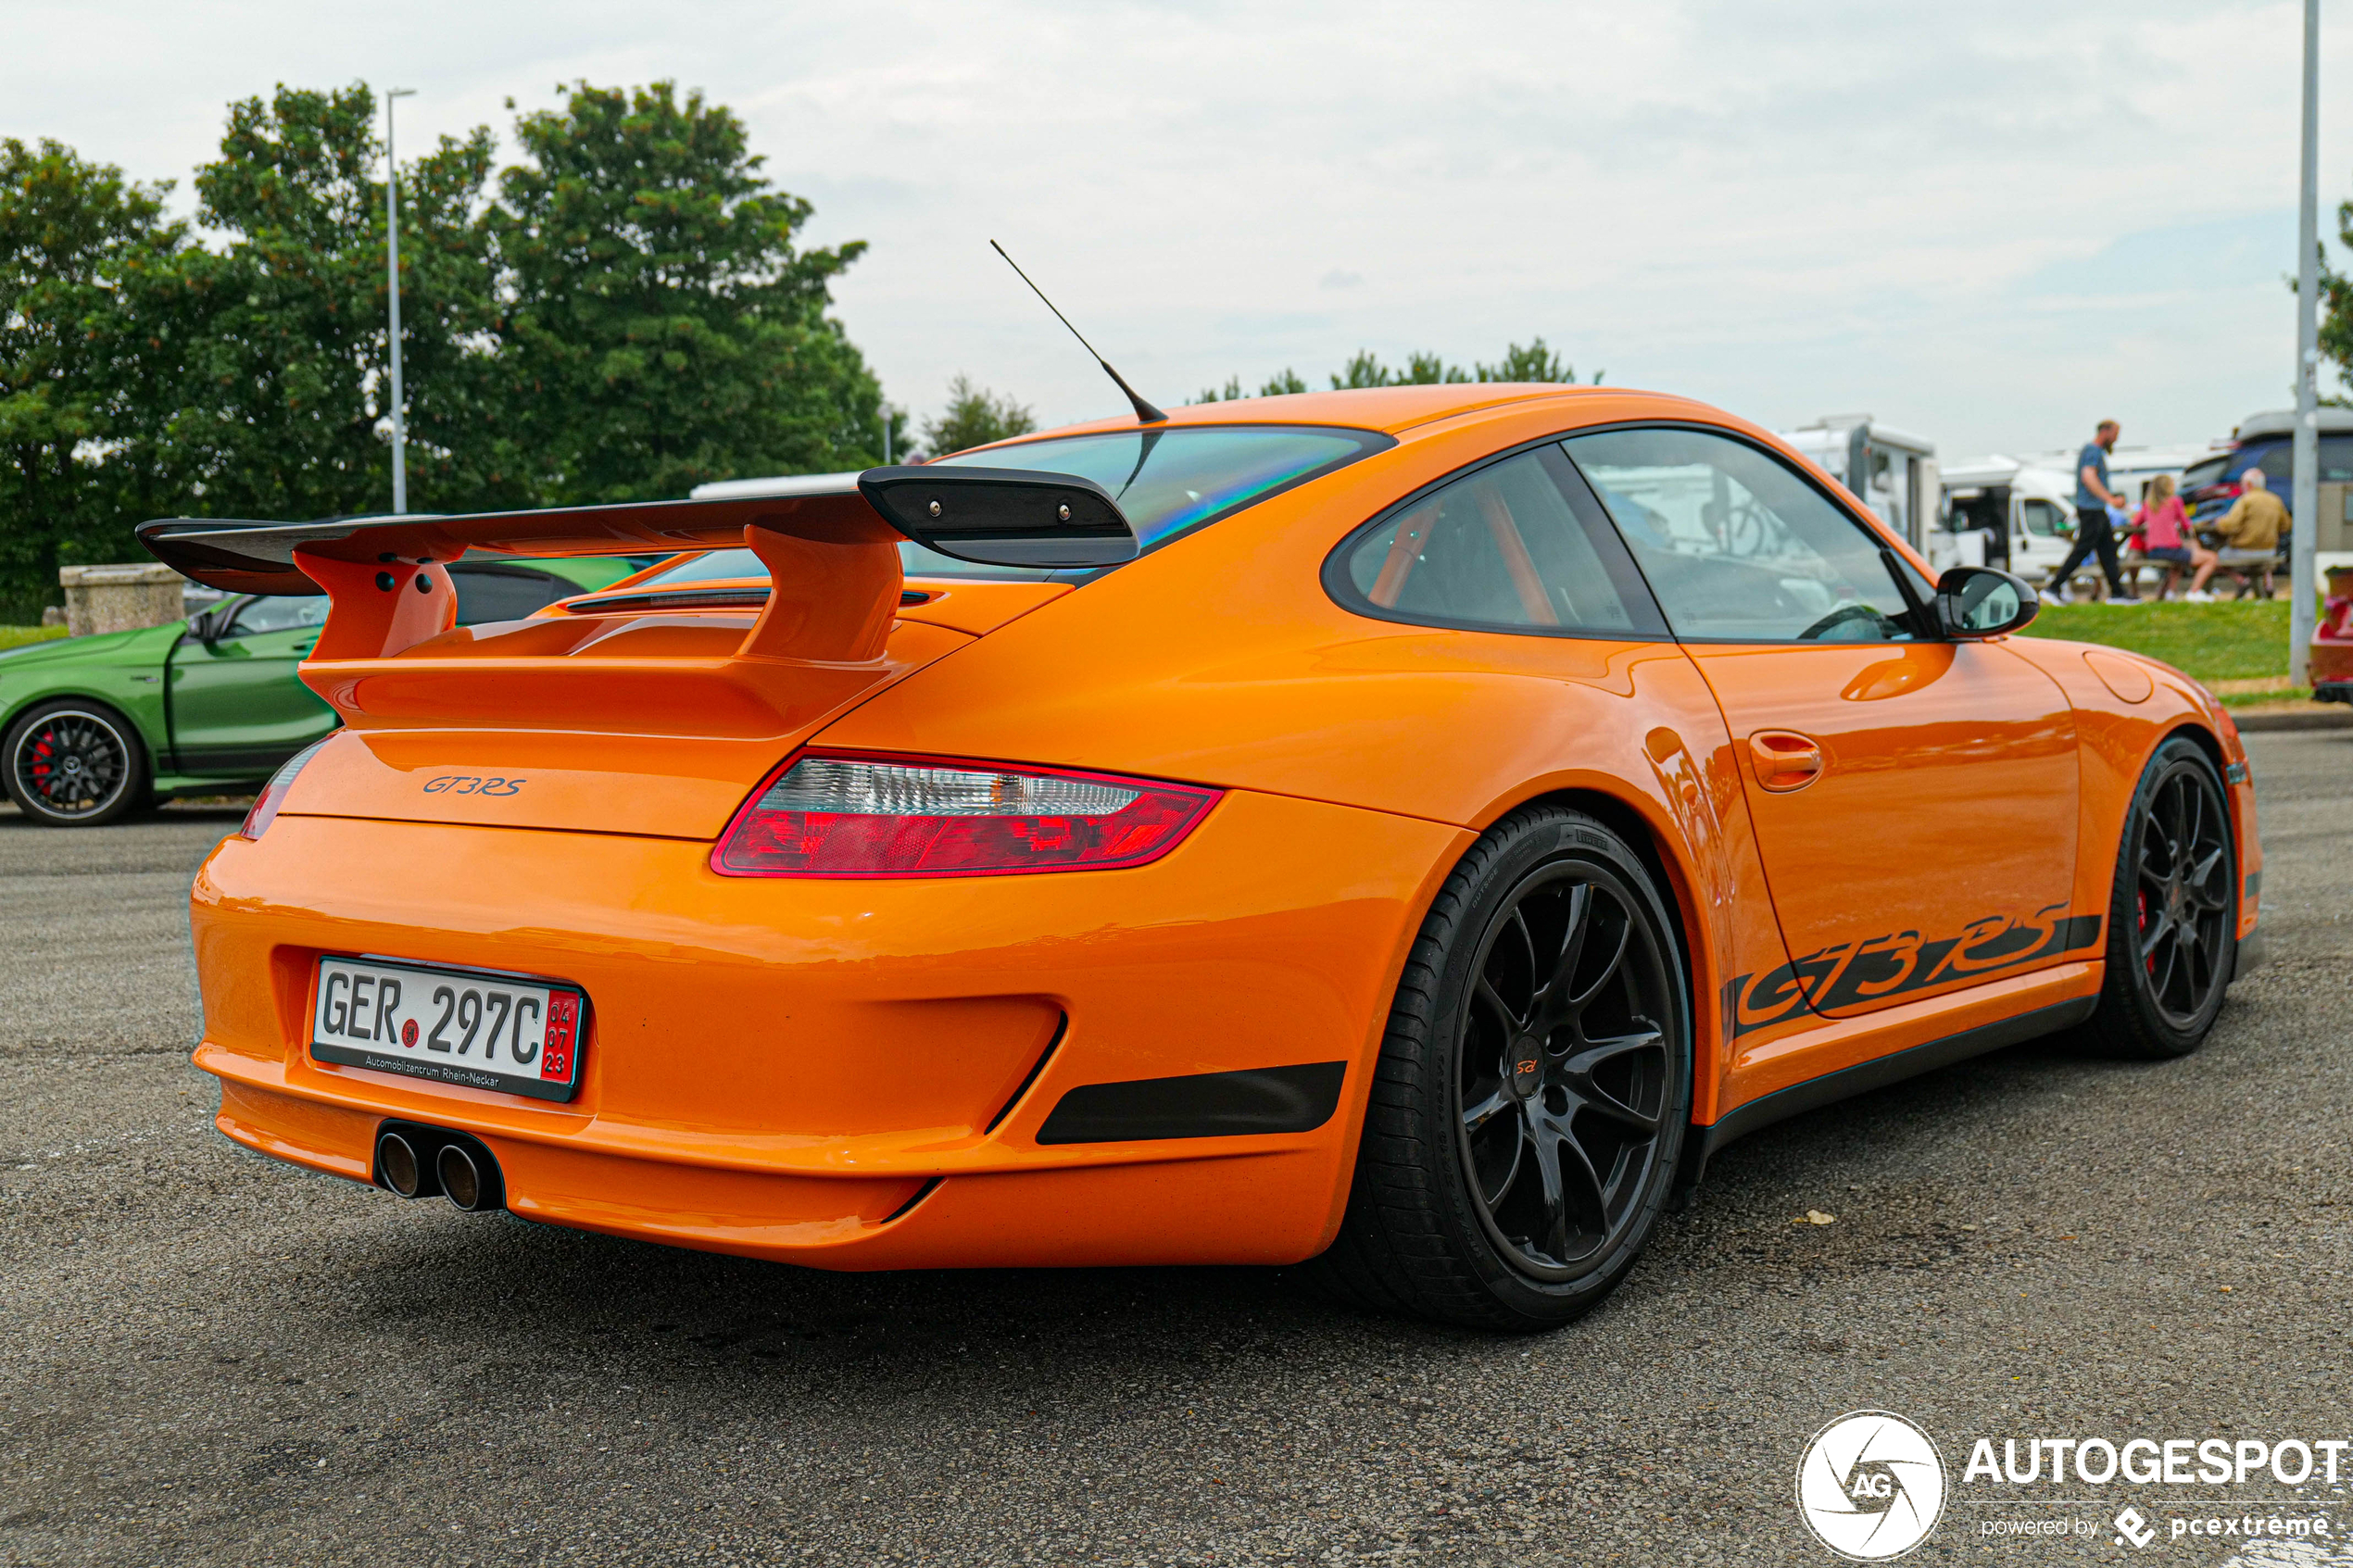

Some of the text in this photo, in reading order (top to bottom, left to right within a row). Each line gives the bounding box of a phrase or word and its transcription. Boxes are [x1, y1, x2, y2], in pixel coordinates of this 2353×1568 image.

[1472, 867, 1499, 909] OUTSIDE
[1737, 929, 1928, 1025] GT3
[322, 971, 541, 1064] GER 297C
[550, 1002, 570, 1025] 04
[547, 1027, 568, 1050] 07
[365, 1055, 499, 1087] Automobilzentrum Rhein-Neckar
[545, 1052, 564, 1073] 23
